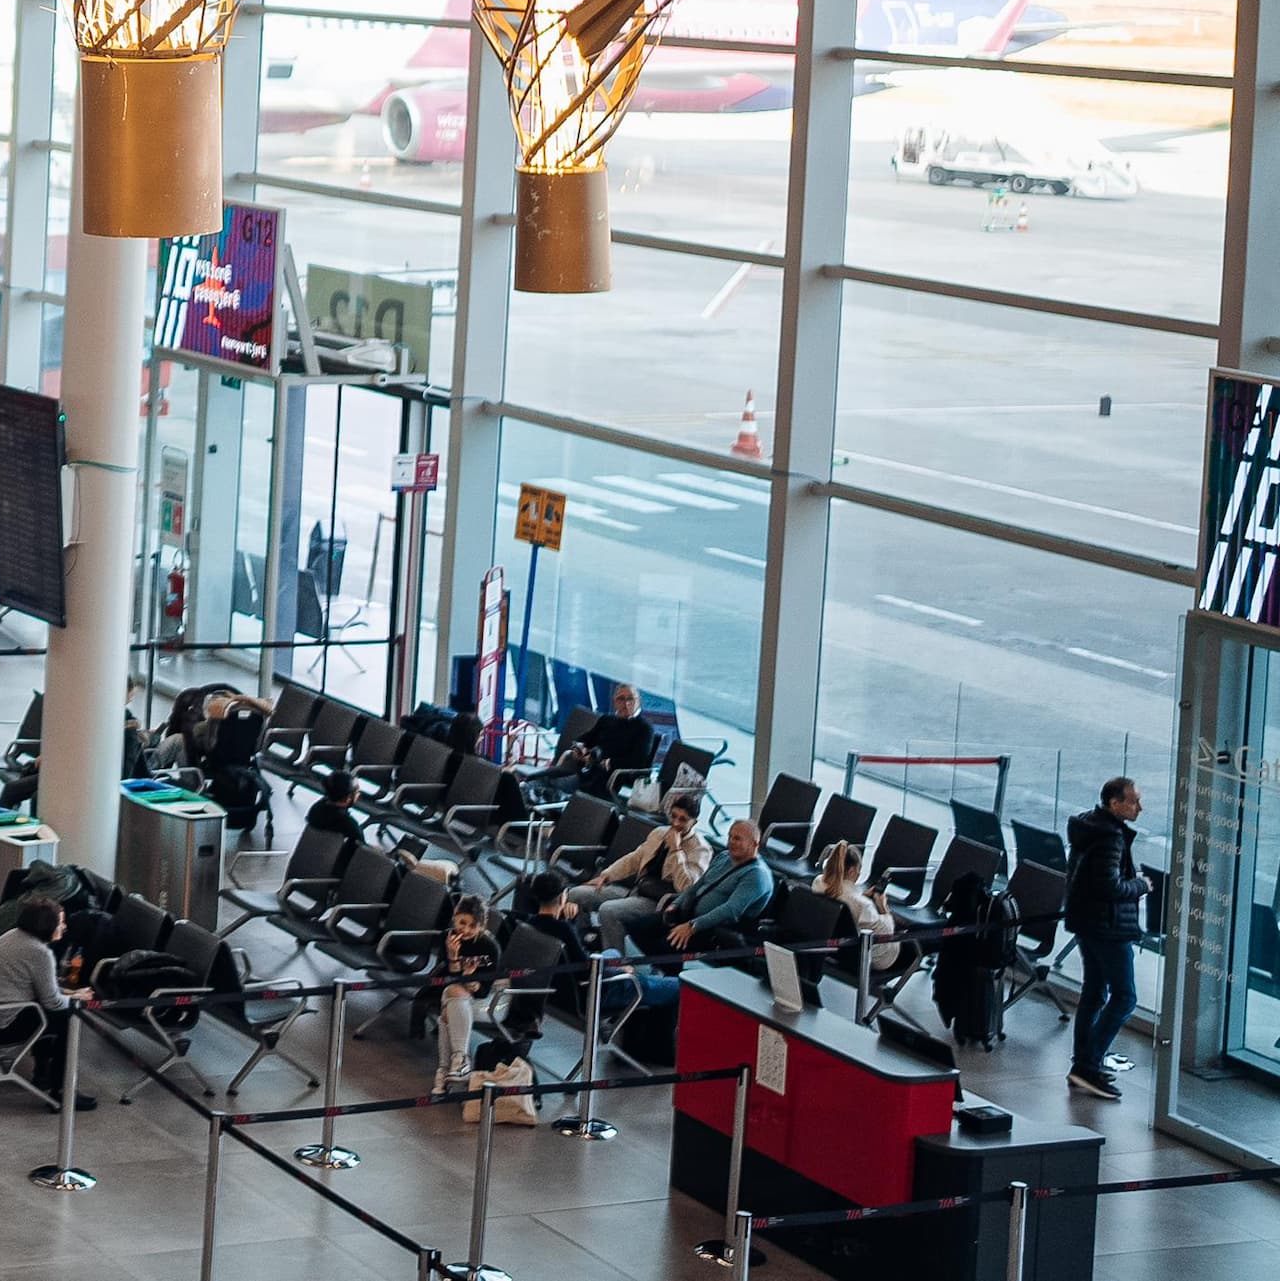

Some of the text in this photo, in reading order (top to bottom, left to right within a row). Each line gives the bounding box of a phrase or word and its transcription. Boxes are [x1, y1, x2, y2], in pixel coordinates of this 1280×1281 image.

[242, 214, 273, 248] G12
[1180, 802, 1205, 820] Hve
[1179, 825, 1203, 843] Bon
[1175, 876, 1205, 894] Gten
